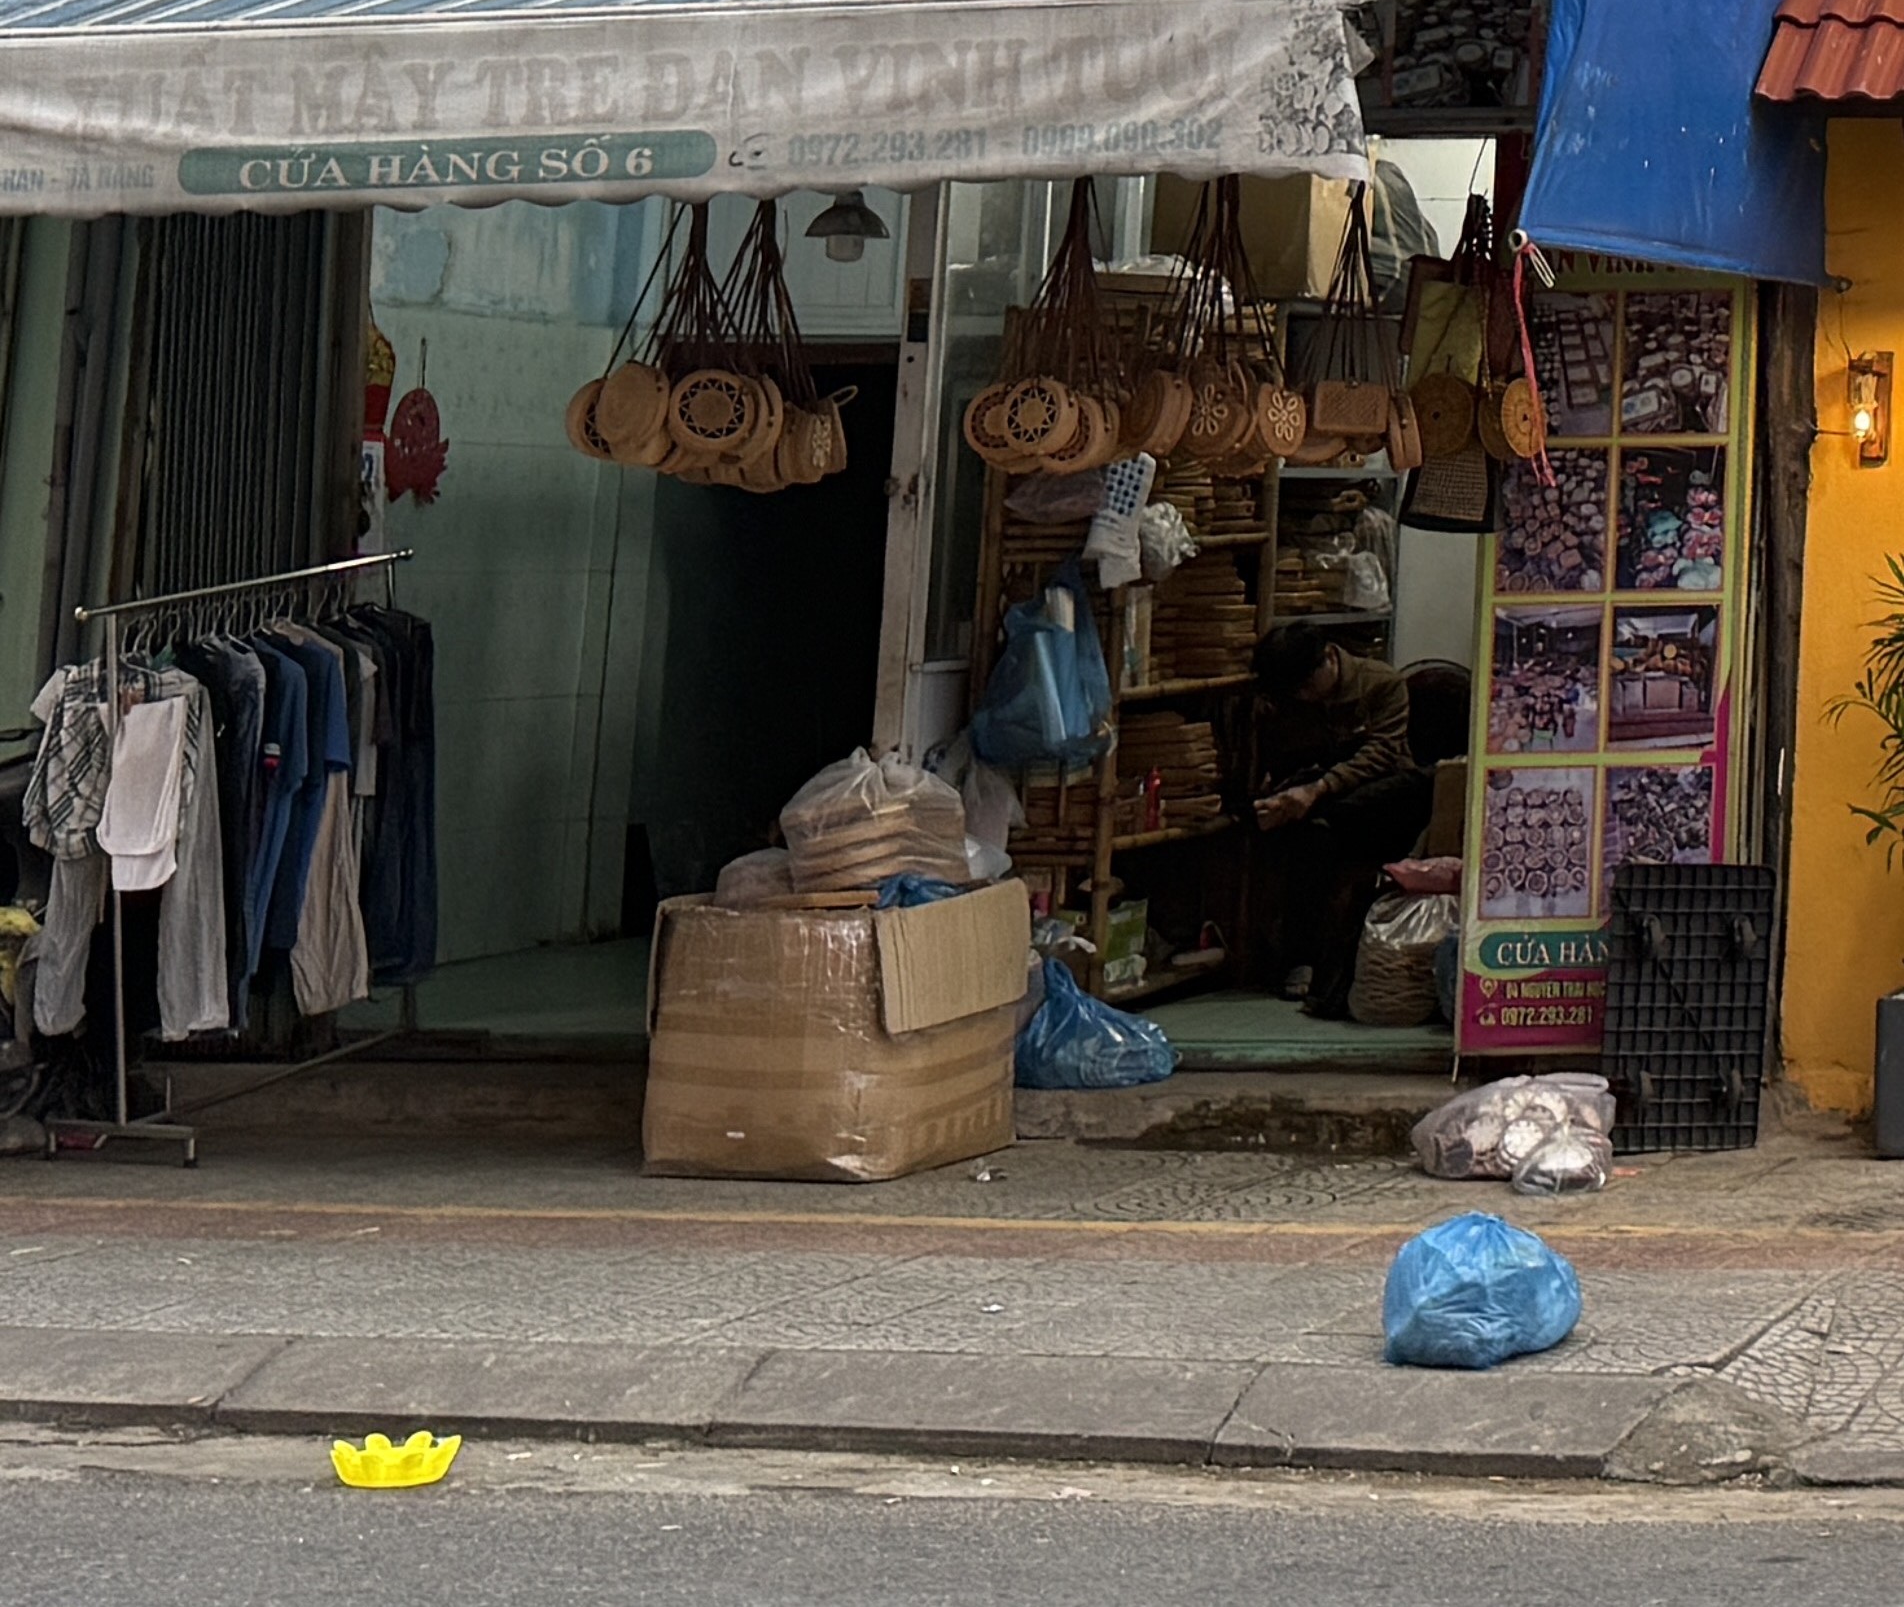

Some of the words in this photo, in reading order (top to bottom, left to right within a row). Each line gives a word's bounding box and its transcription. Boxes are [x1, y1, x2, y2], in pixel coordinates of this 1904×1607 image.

[368, 143, 524, 186] HÀNG
[538, 135, 612, 179] SỐ
[624, 146, 654, 177] 6
